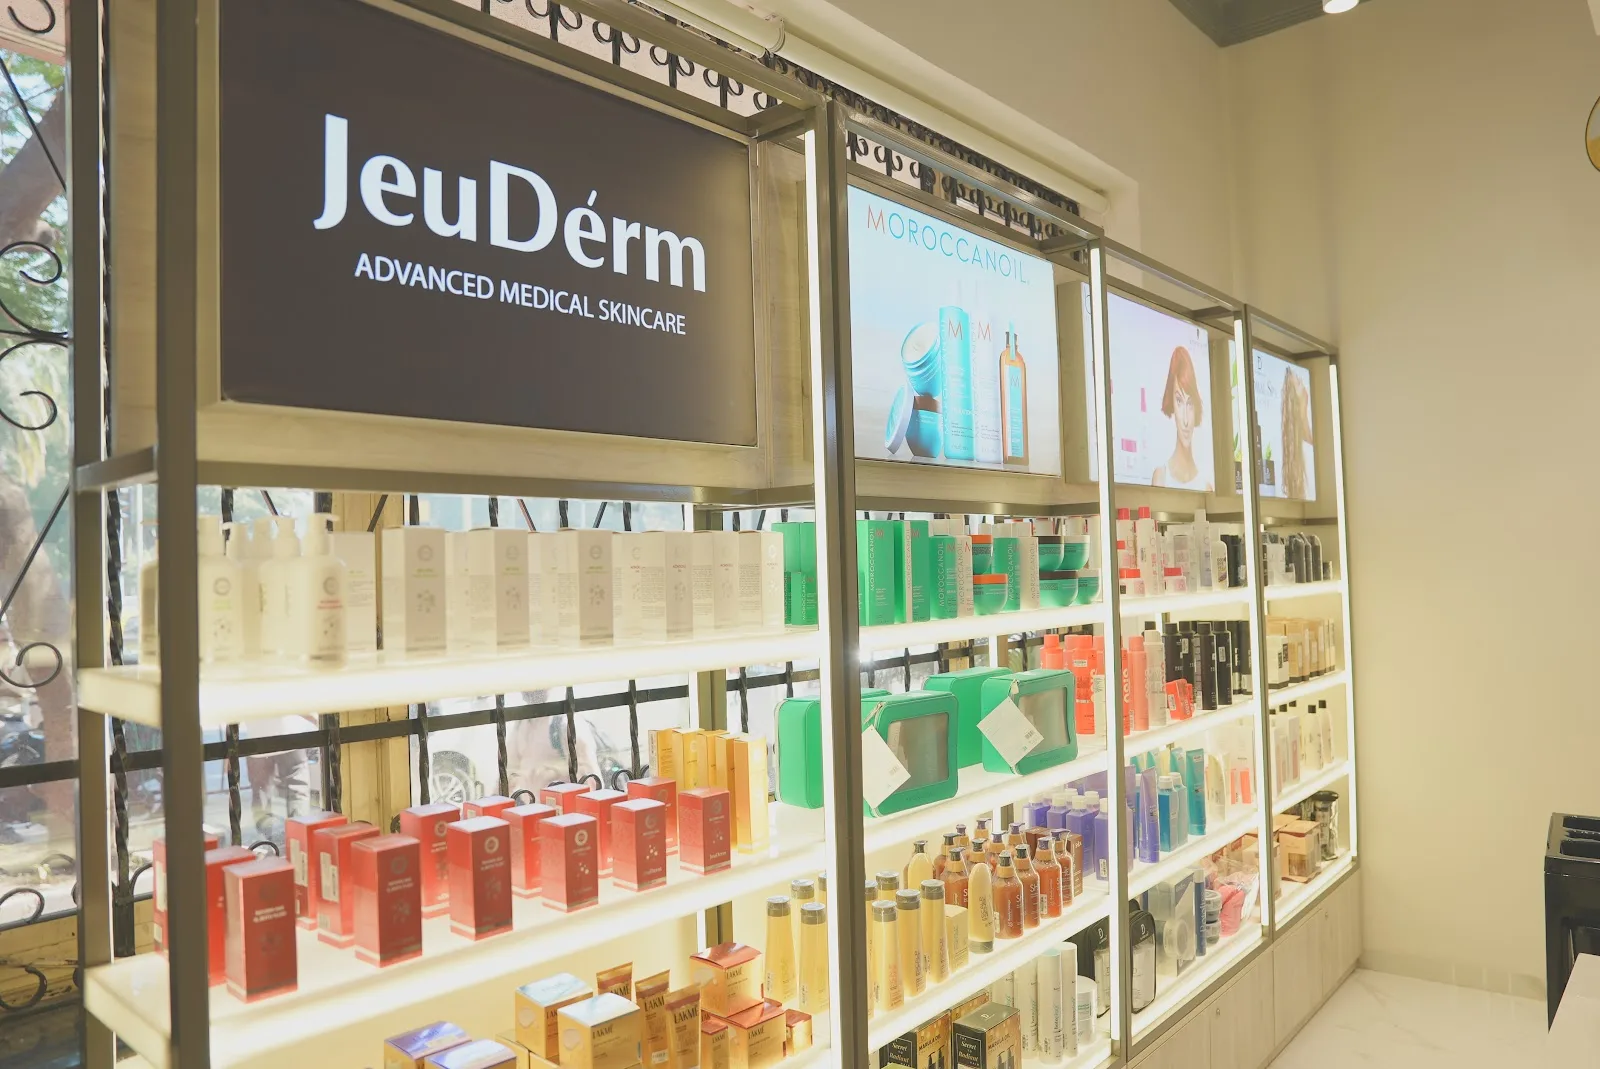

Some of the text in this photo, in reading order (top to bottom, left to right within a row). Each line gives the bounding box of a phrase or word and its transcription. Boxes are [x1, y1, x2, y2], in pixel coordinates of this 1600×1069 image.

[313, 113, 706, 293] JeuDérm
[354, 252, 686, 335] ADVANCED MEDICAL SKINCARE
[937, 541, 945, 607] MOROCCANOIL
[609, 983, 631, 996] AKMÉ
[644, 995, 665, 1012] LAKM
[891, 1042, 908, 1052] Secret
[960, 1041, 977, 1051] Secret
[958, 1051, 979, 1062] Radiant
